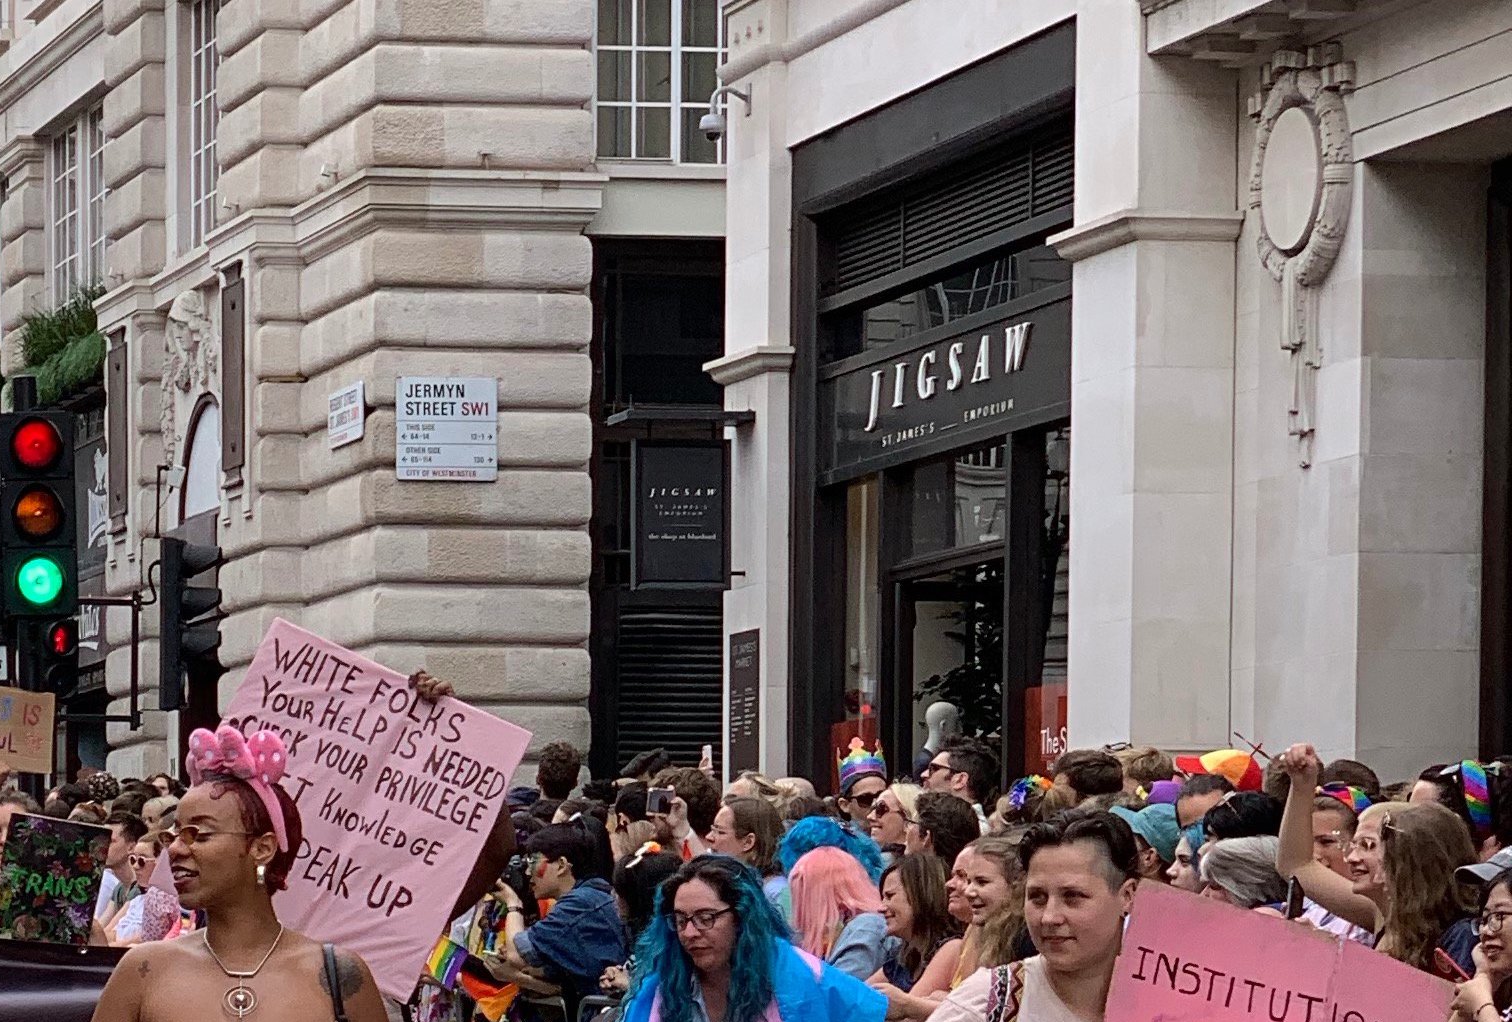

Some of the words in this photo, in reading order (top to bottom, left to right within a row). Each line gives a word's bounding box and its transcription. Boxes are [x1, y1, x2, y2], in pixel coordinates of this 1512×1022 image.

[405, 384, 465, 398] JERMYN
[864, 321, 1033, 432] JIGSAW
[405, 401, 457, 416] STREET
[461, 402, 489, 416] SW1
[963, 398, 1014, 423] EMPORIUM
[649, 488, 717, 498] JIGSAW
[23, 703, 42, 726] IS
[274, 637, 364, 695] WHITE
[369, 677, 466, 744] FOLKS
[261, 675, 314, 724] YOUR
[319, 695, 388, 746] HELP
[390, 725, 423, 760] IS
[423, 746, 506, 801] NEEDED
[313, 737, 369, 785] YOUR
[374, 765, 489, 834] PRIVILEGE
[319, 787, 444, 867] KNOWLEDGE
[10, 866, 92, 905] TRANS
[294, 836, 362, 900] PEAK
[367, 873, 414, 918] UP
